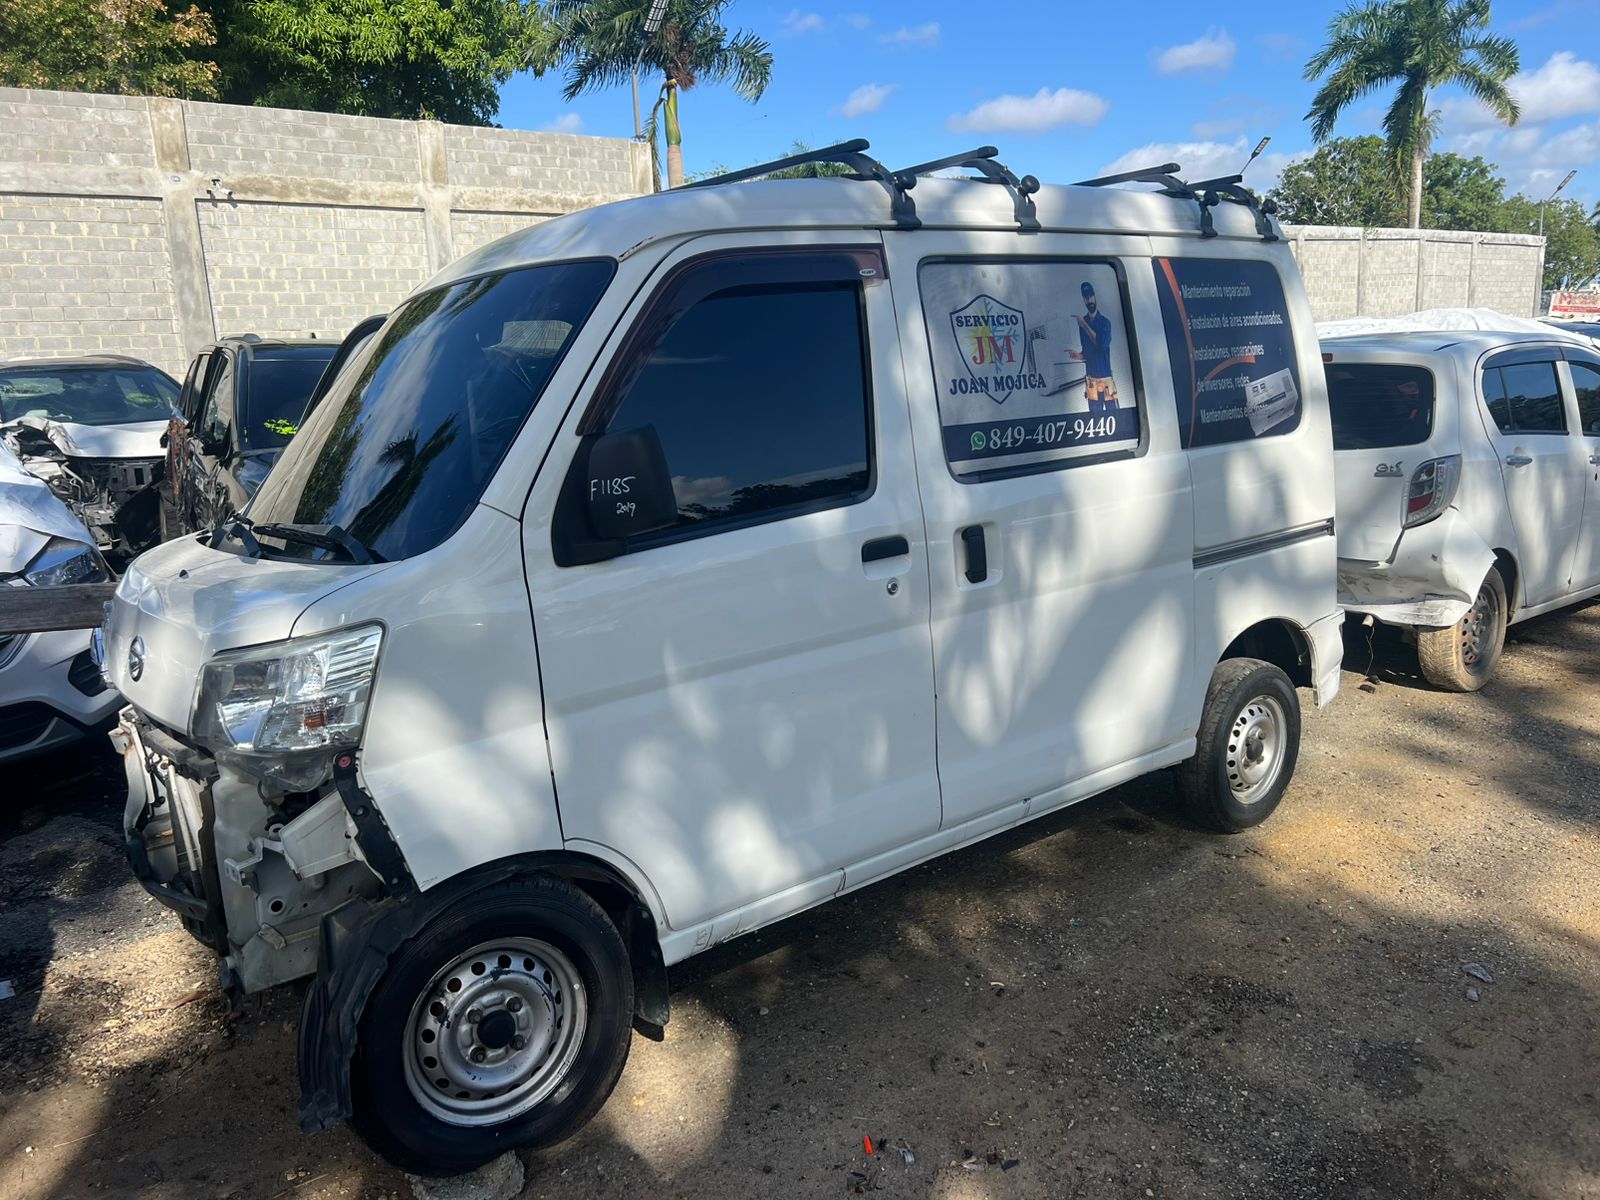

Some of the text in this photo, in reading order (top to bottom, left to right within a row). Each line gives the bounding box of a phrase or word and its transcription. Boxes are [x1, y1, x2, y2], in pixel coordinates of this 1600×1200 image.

[956, 314, 1019, 328] SERVICIO
[1222, 313, 1230, 327] de
[972, 335, 1016, 365] JM
[950, 373, 1047, 395] JOAN MOJICA
[989, 415, 1116, 450] 849-407-9440
[590, 476, 636, 501] F1185
[616, 502, 636, 517] 2019
